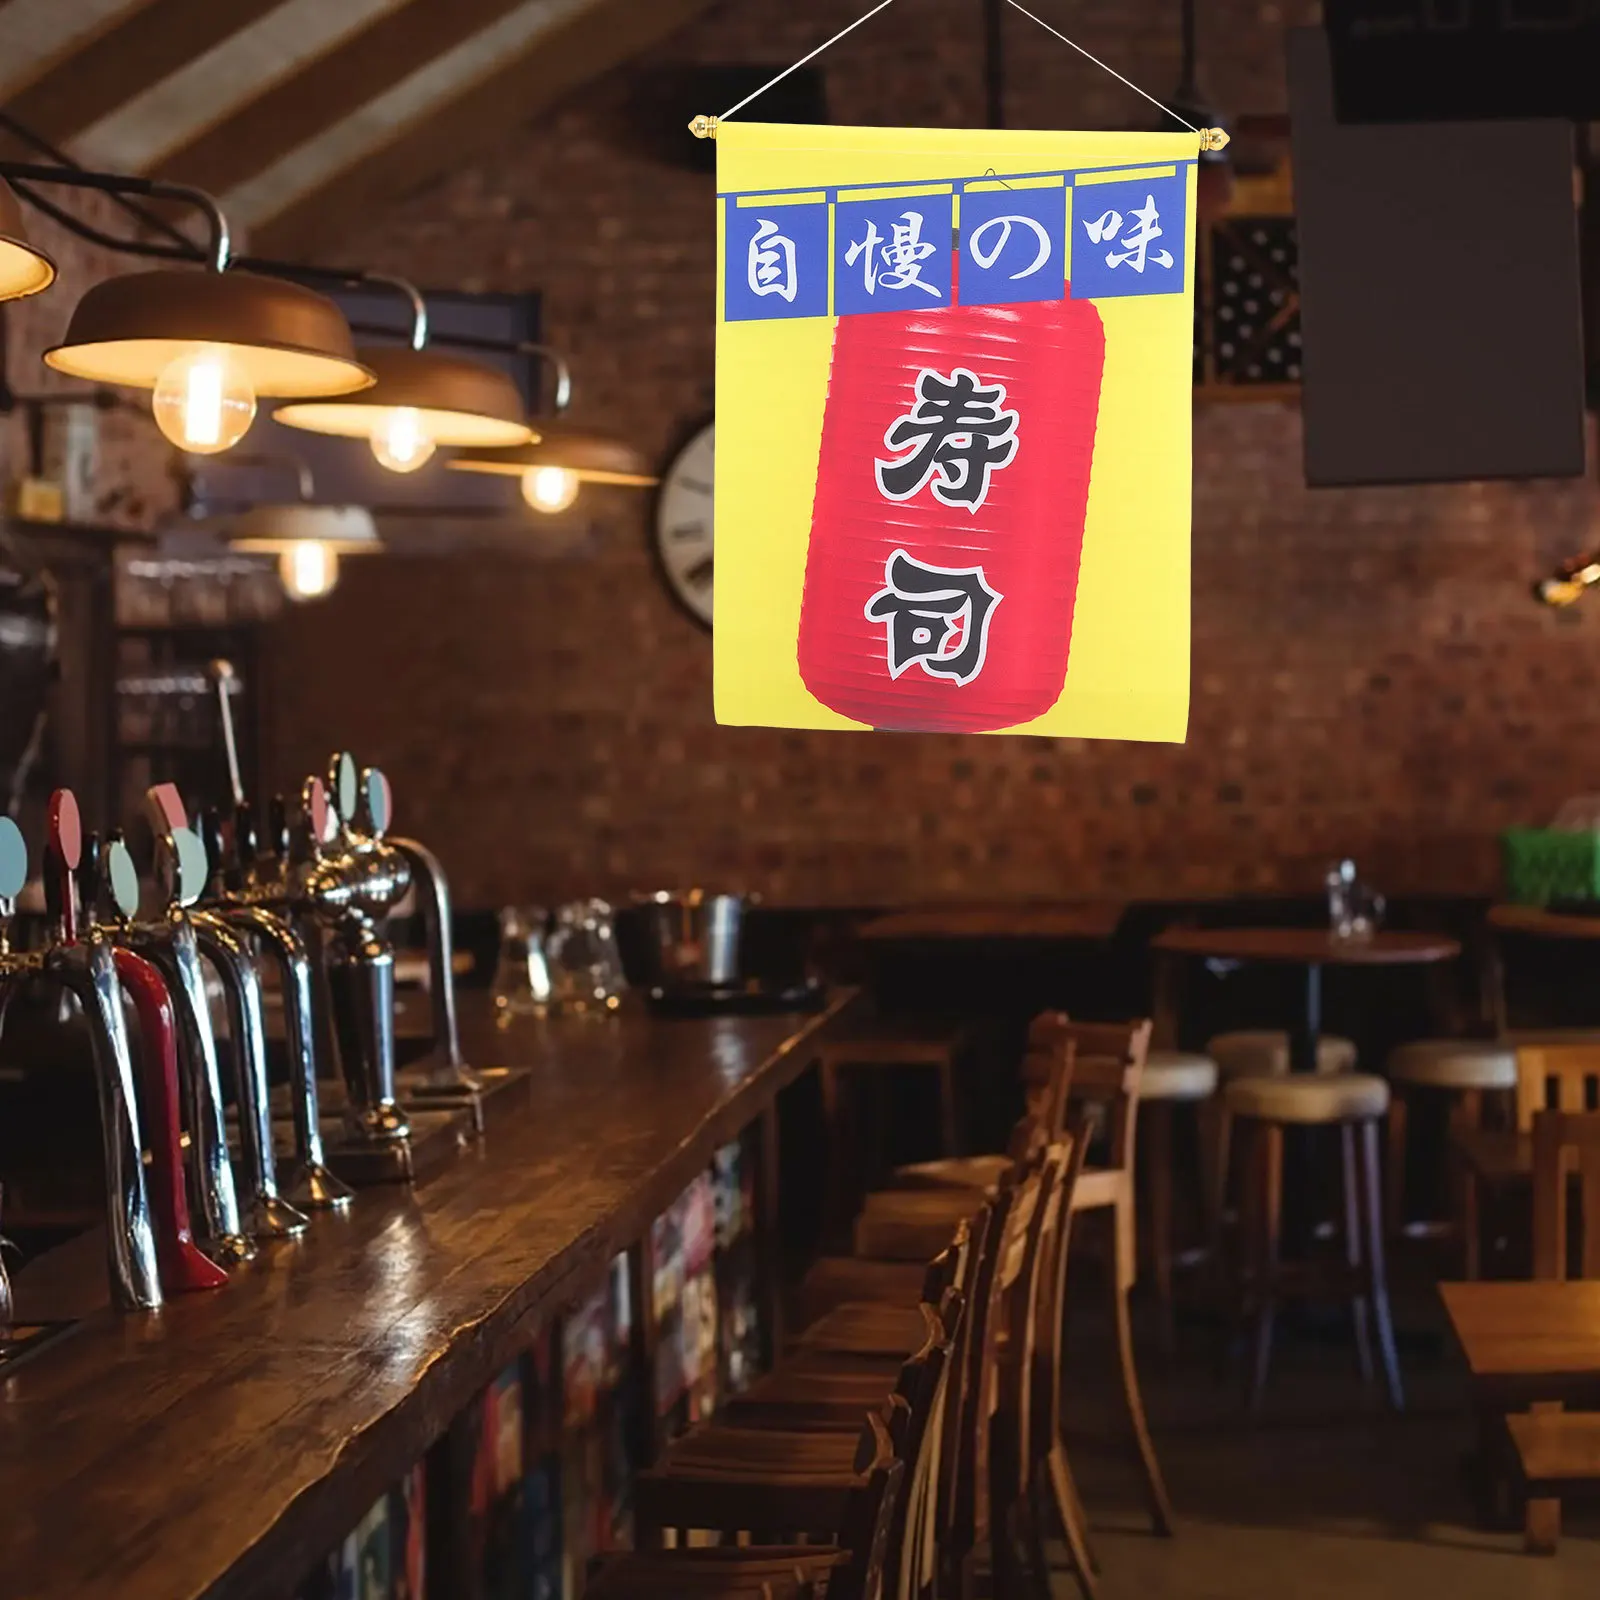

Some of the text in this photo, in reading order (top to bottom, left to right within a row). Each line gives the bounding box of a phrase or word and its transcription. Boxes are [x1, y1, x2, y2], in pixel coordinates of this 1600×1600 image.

[746, 194, 1173, 304] 自慢の味
[864, 367, 1021, 688] 寿司
